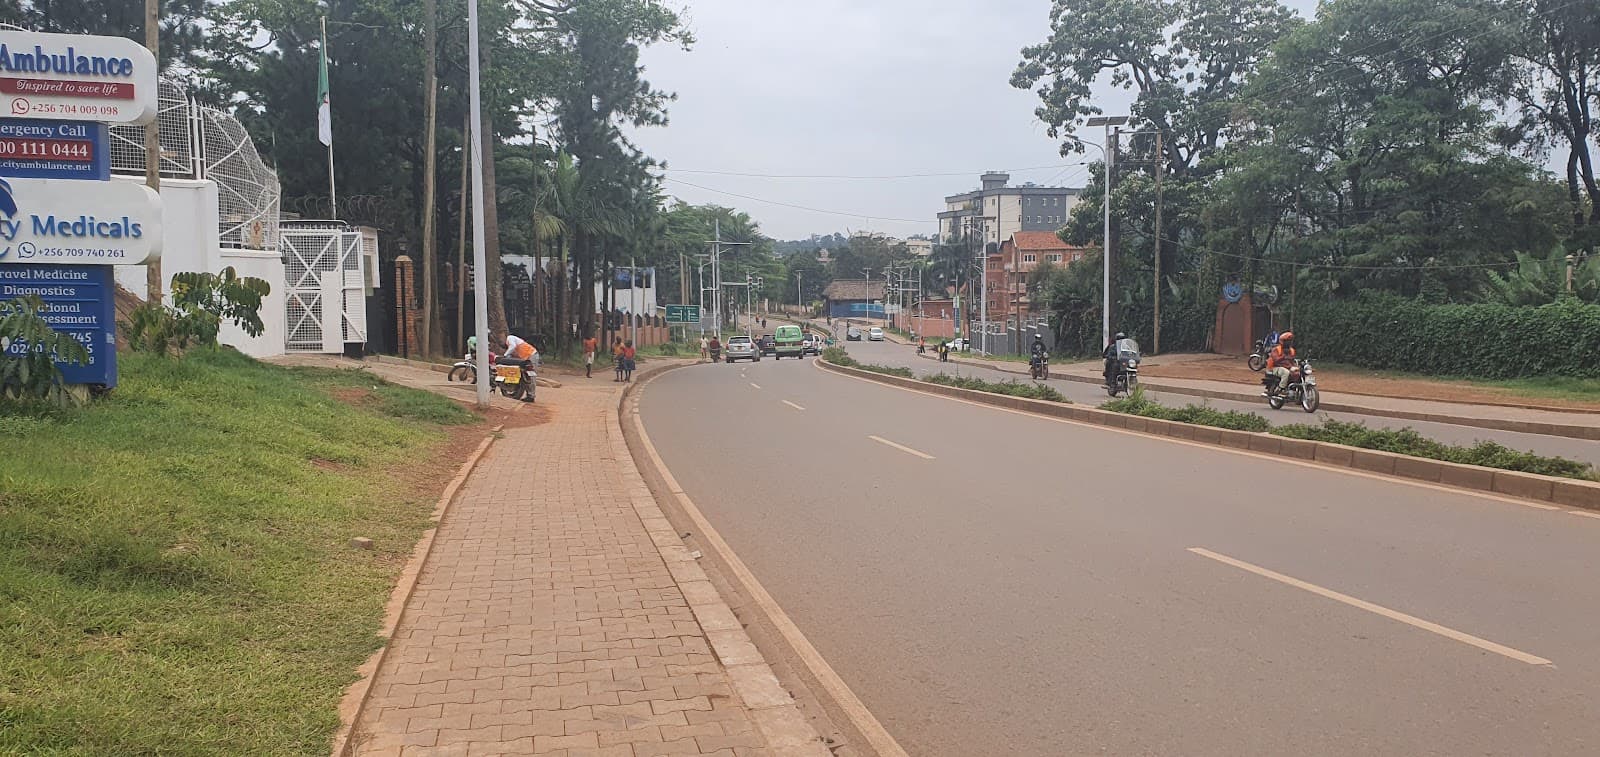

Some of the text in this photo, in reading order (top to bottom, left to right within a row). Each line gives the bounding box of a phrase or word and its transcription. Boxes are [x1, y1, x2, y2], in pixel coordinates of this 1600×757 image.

[0, 44, 133, 76] Ambulance
[16, 80, 118, 96] Inspired to save life
[32, 103, 118, 115] +256 704 009 098
[59, 124, 86, 137] Call
[21, 142, 47, 155] 111
[52, 143, 88, 157] 0444
[31, 214, 142, 239] Medicals
[38, 248, 125, 258] +256 709 740 261
[33, 269, 88, 280] Medicine
[4, 285, 76, 296] Diagnostics
